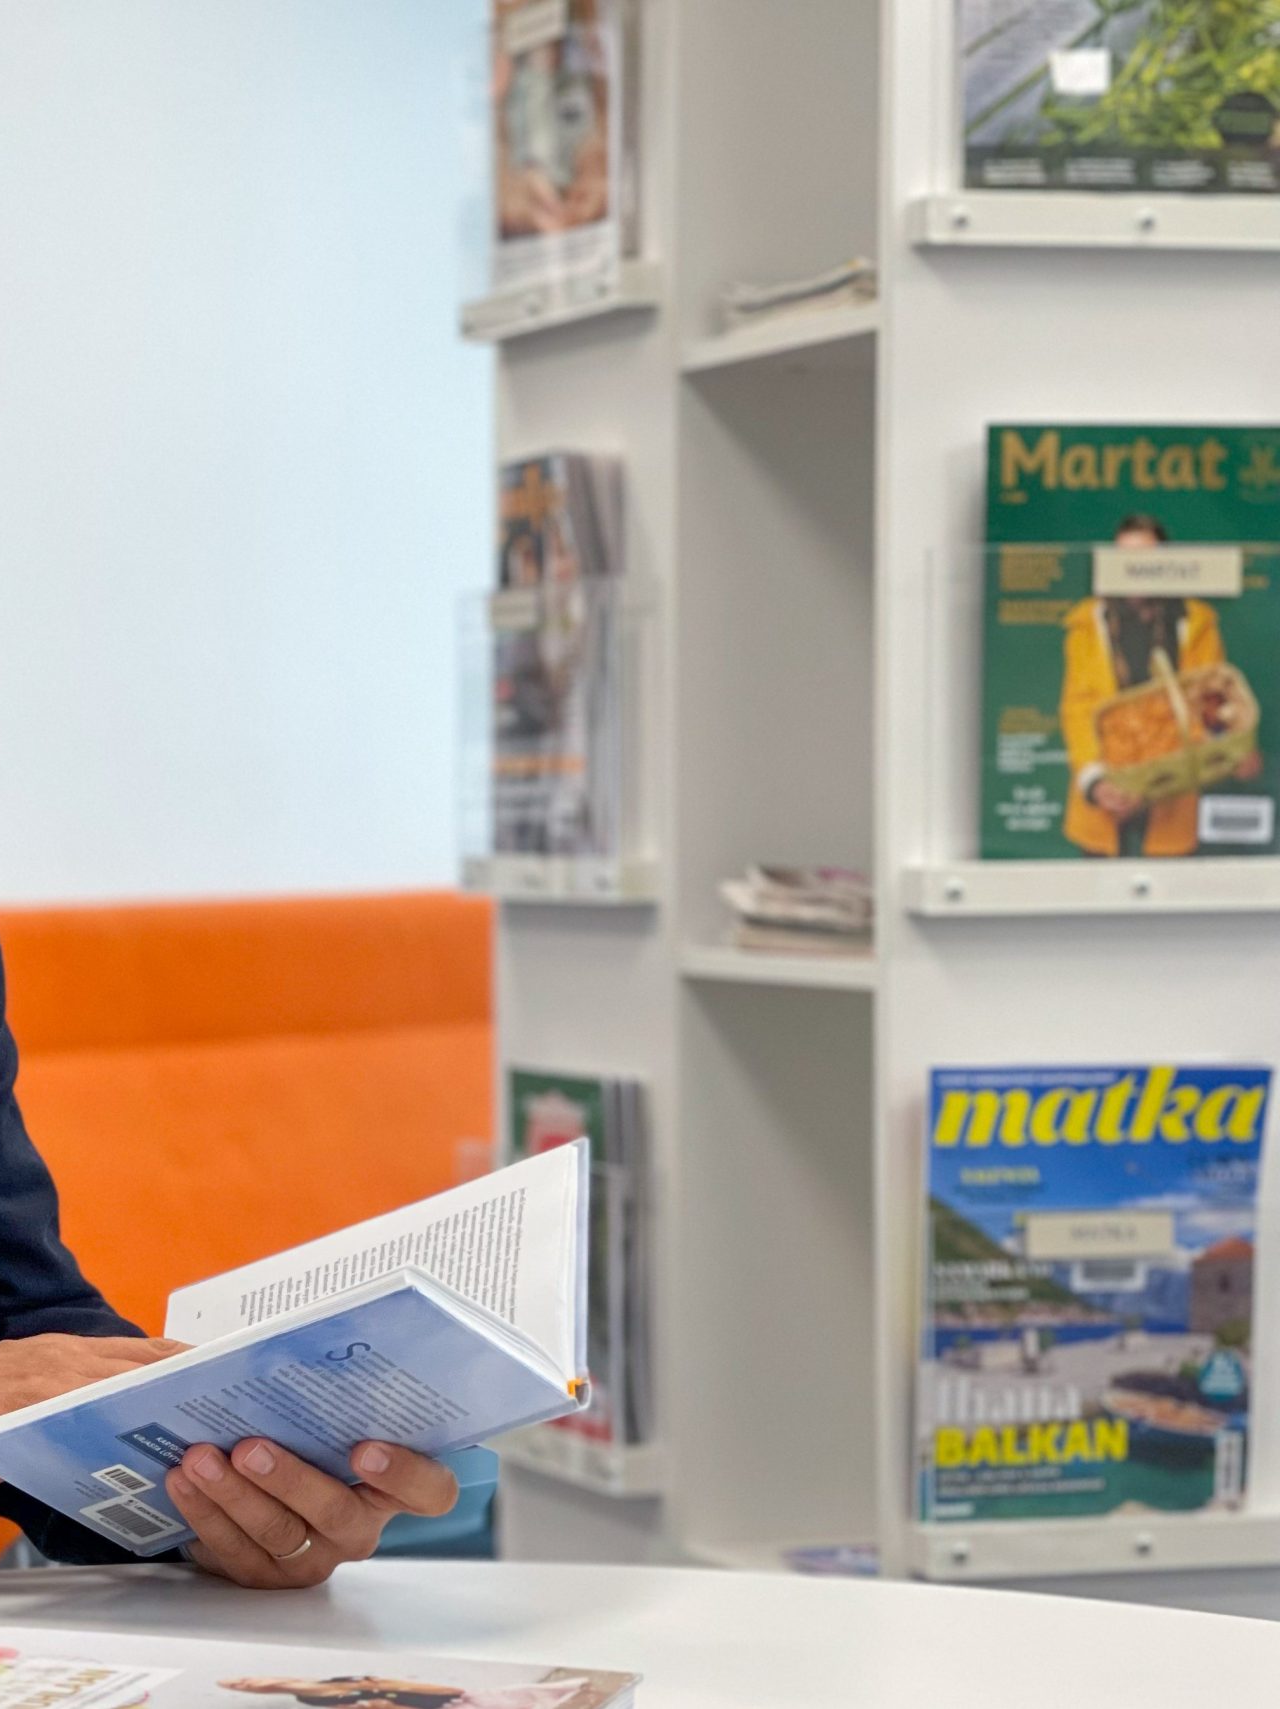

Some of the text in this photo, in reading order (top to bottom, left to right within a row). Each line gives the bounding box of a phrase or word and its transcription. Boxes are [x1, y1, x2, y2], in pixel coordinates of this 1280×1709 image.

[1000, 430, 1227, 490] Martat
[933, 1066, 1265, 1147] matka
[935, 1418, 1130, 1468] BALKAN
